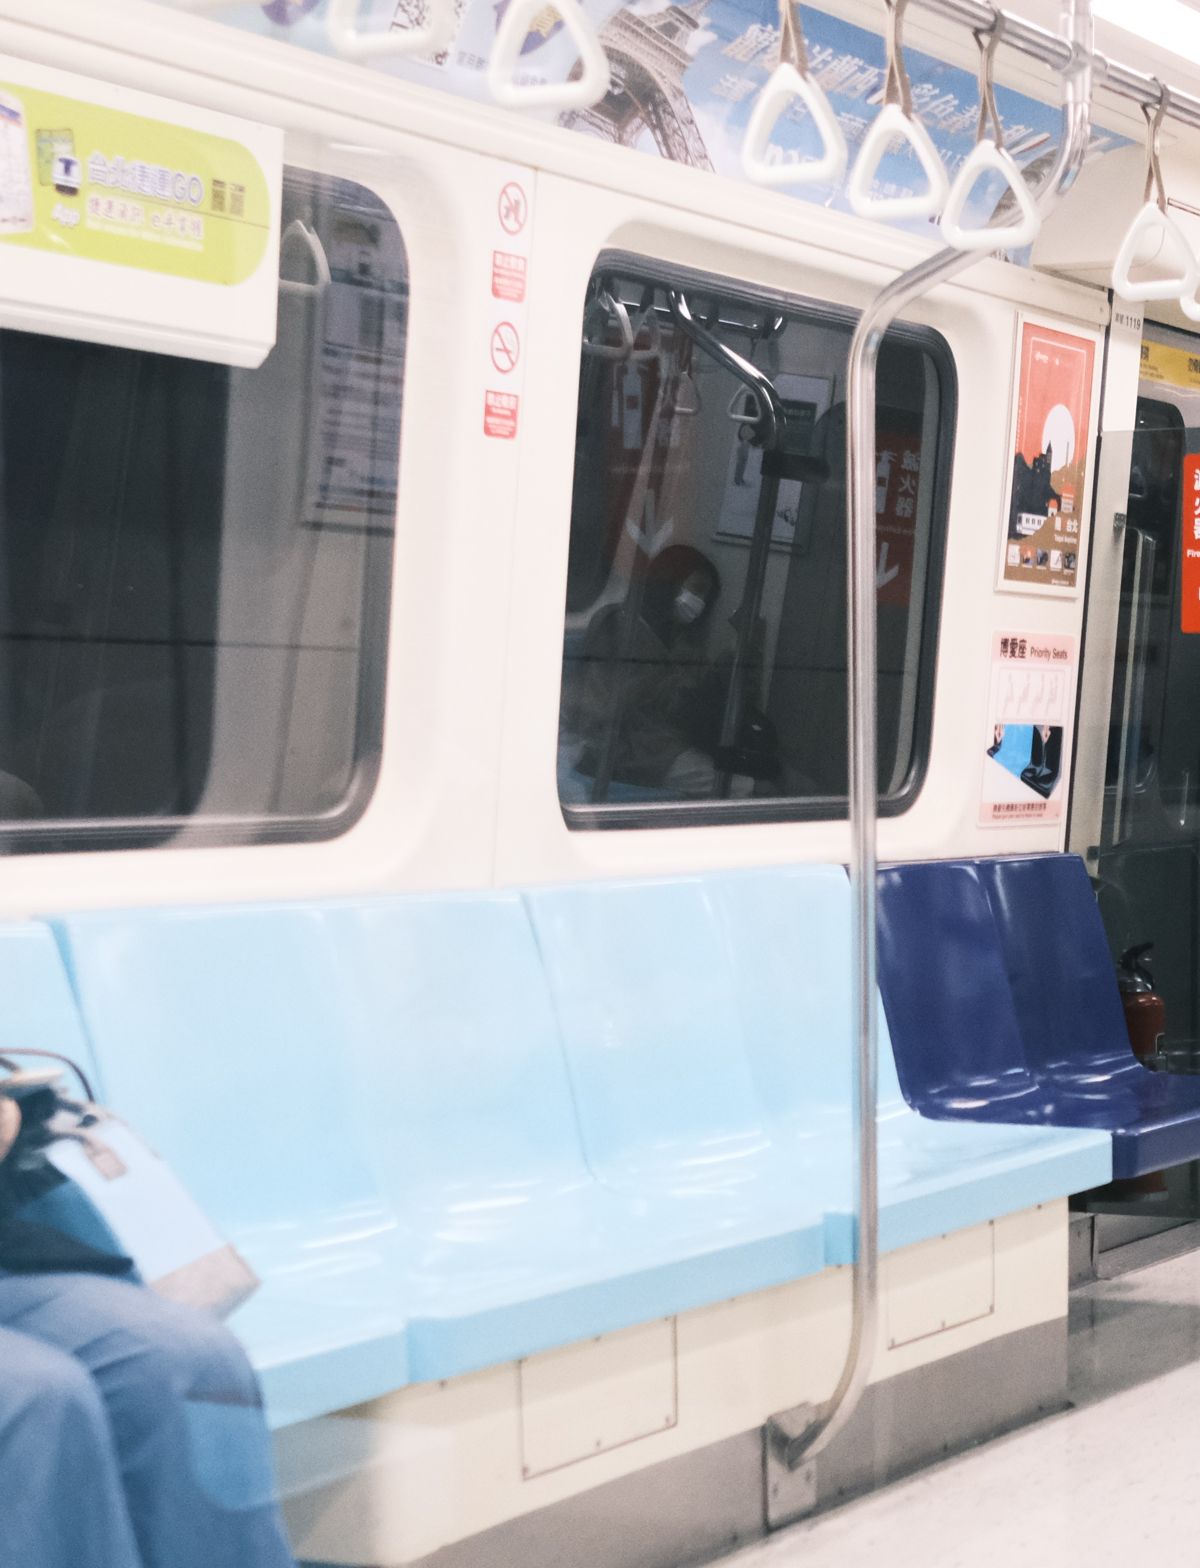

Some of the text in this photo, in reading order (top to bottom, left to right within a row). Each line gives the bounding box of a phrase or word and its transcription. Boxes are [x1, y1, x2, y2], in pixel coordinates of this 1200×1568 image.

[1187, 549, 1200, 558] Fire
[1030, 646, 1051, 661] Priority
[1052, 648, 1068, 660] Seats
